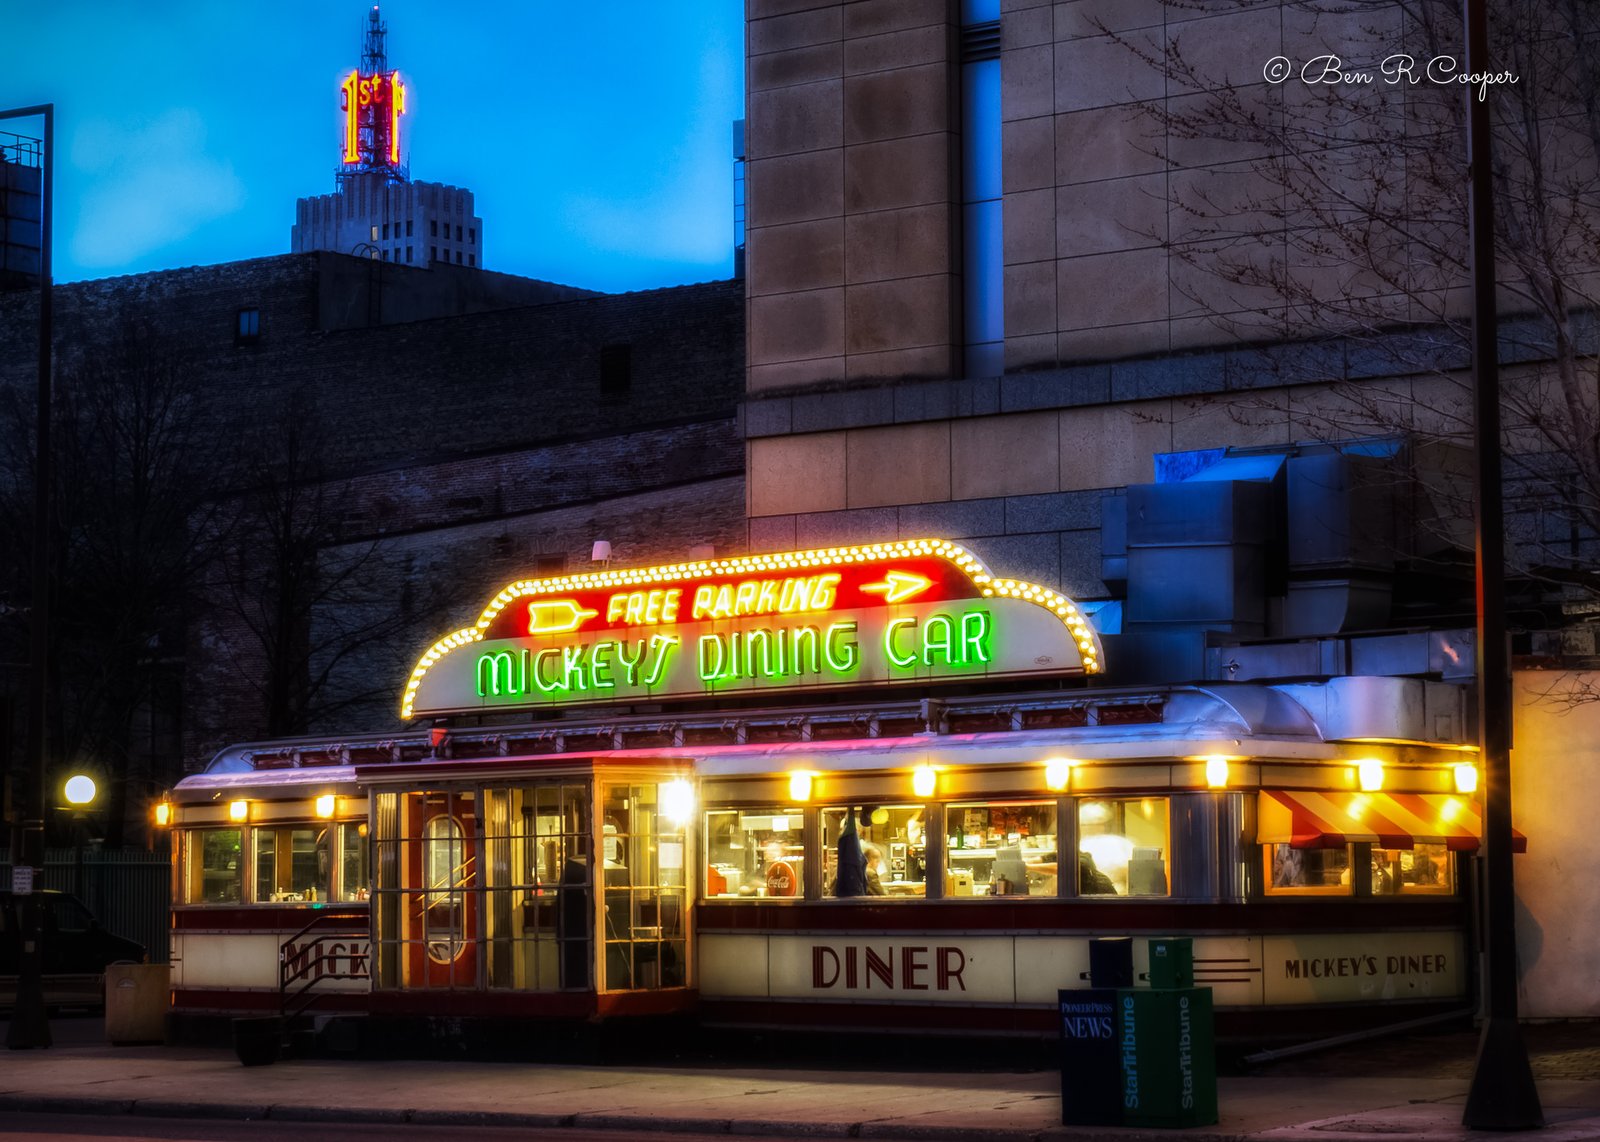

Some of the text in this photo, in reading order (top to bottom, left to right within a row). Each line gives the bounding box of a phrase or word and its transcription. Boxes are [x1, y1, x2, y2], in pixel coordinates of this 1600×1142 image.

[606, 573, 842, 626] FREE PARKING
[699, 620, 858, 681] DINING
[886, 609, 991, 668] CAR
[812, 946, 966, 991] DINER
[1285, 954, 1447, 979] MICKEY'S DINER
[1064, 1017, 1113, 1039] NEWS
